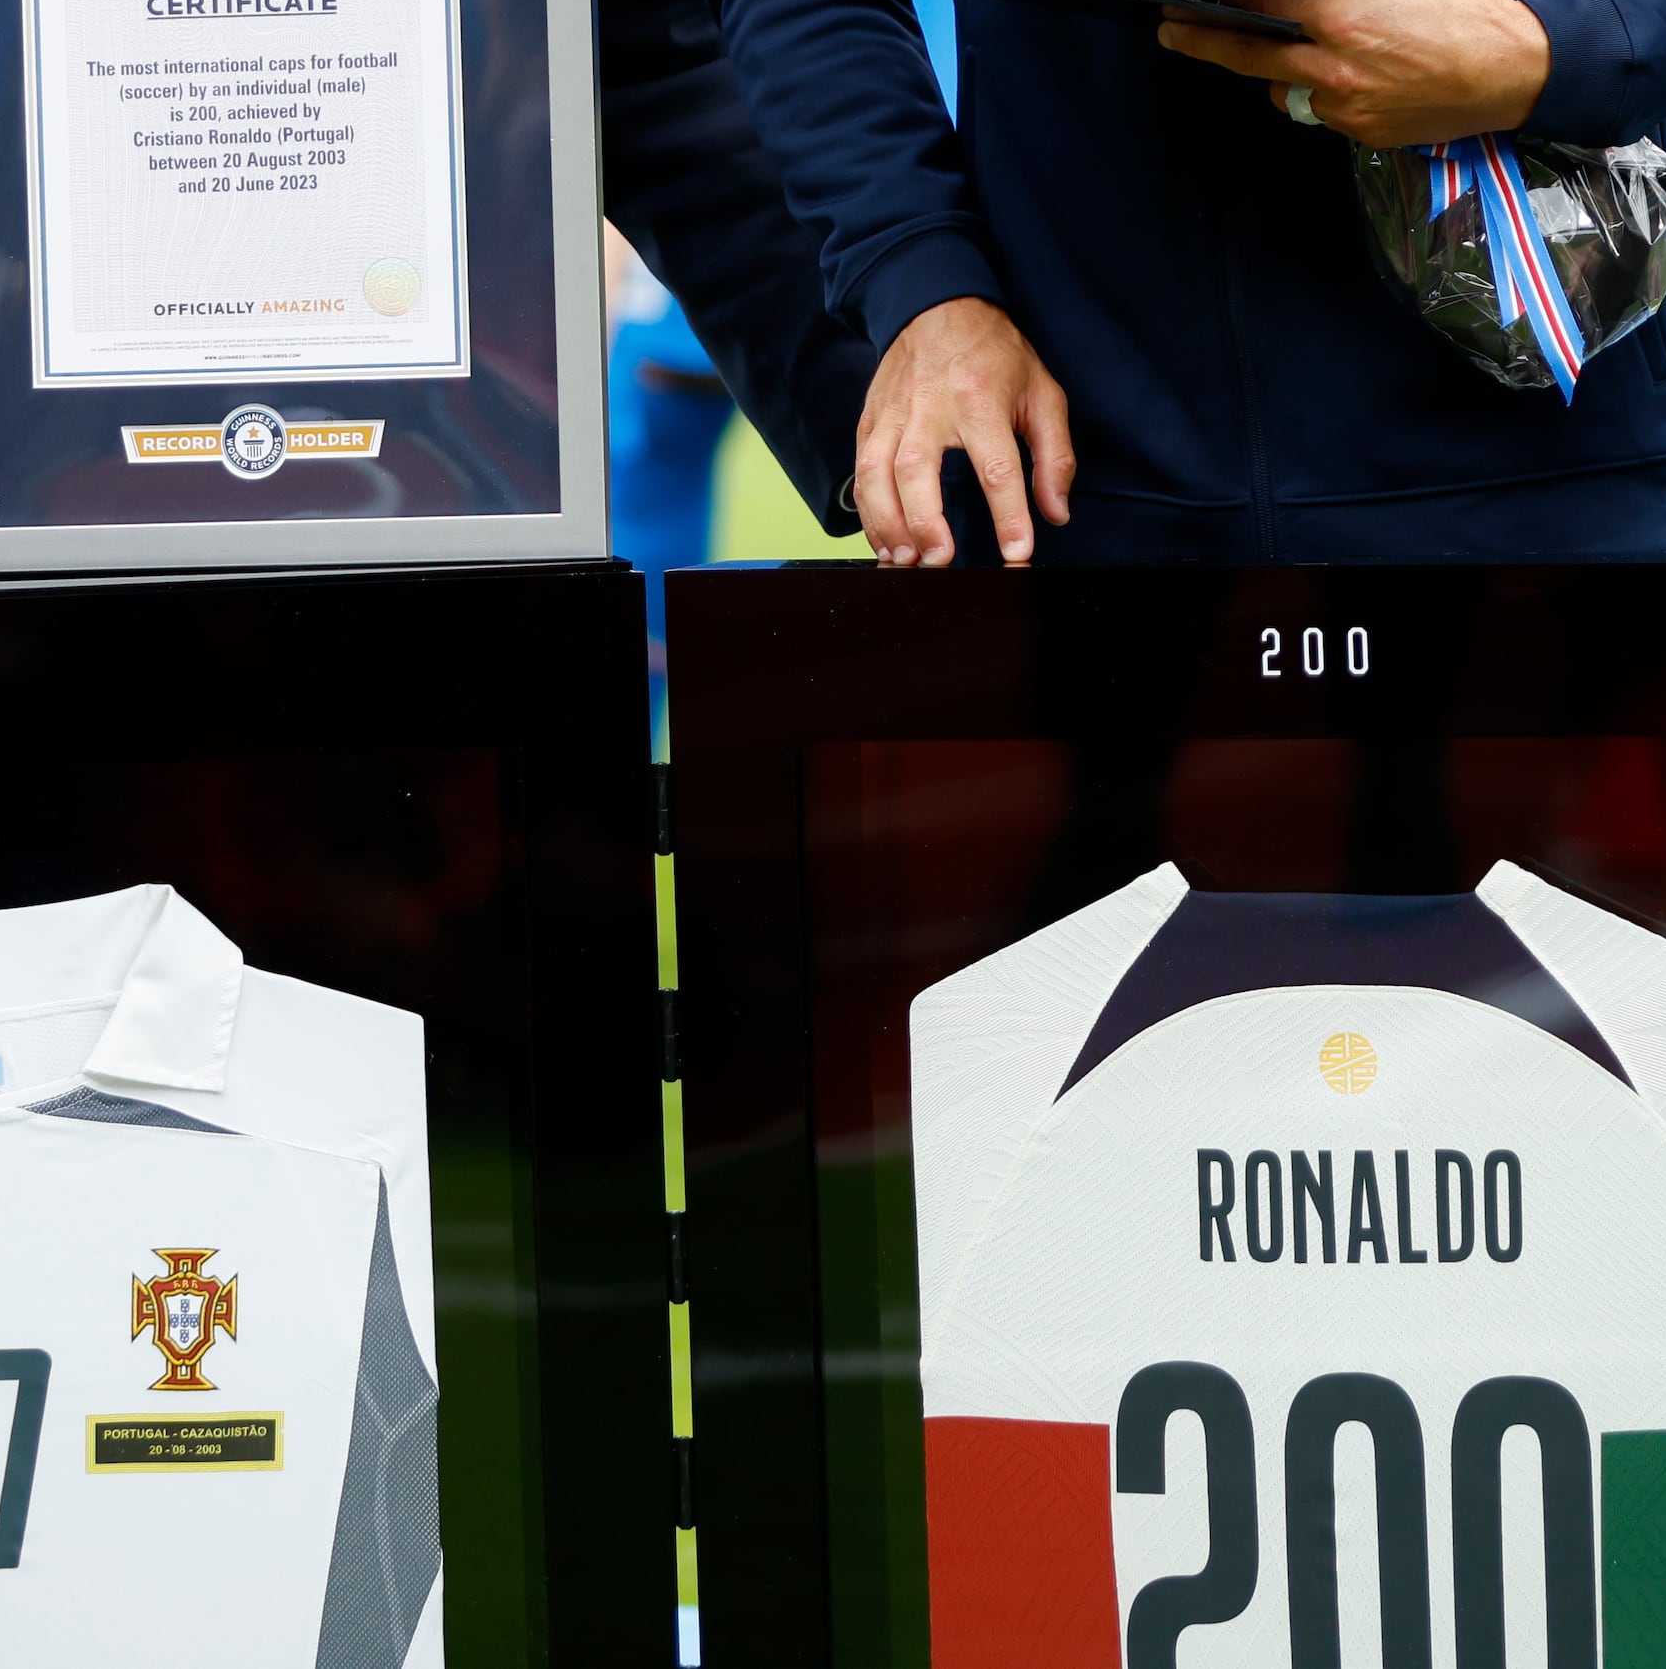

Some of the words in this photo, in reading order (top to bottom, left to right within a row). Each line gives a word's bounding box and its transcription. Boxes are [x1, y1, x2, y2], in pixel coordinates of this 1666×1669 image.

[87, 61, 115, 77] The
[121, 61, 159, 76] most
[164, 56, 263, 74] international
[269, 58, 305, 75] caps
[310, 54, 332, 70] for
[338, 52, 397, 69] football
[119, 83, 183, 102] (soccer)
[189, 82, 206, 100] by
[212, 85, 230, 97] an
[236, 79, 311, 96] individual
[317, 77, 365, 96] (male)
[170, 107, 183, 122] is
[189, 106, 221, 123] 200,
[227, 103, 297, 120] achieved
[303, 103, 321, 121] by
[134, 130, 203, 147] Cristiano
[209, 128, 271, 145] Ronaldo
[277, 125, 354, 146] (Portugal)
[149, 154, 217, 170] between
[223, 153, 241, 168] 20
[247, 151, 302, 170] August
[308, 150, 346, 165] 2003
[178, 178, 206, 193] and
[212, 177, 230, 192] 20
[236, 176, 274, 192] June
[280, 175, 317, 190] 2023
[154, 301, 255, 317] OFFICIALLY
[262, 299, 345, 313] AMAZING
[230, 413, 277, 431] GUINNESS
[142, 435, 217, 452] RECORD
[290, 432, 365, 447] HOLDER
[225, 437, 248, 468] WORLD
[250, 436, 282, 470] RECORDS
[1260, 627, 1370, 676] 200
[1196, 1147, 1523, 1264] RONALDO
[103, 1428, 170, 1440] PORTUGAL
[180, 1424, 268, 1439] CAZAQUISTÃO
[149, 1444, 163, 1455] 20
[172, 1444, 186, 1455] 08
[196, 1444, 222, 1455] 2003
[1116, 1360, 1599, 1669] 200
